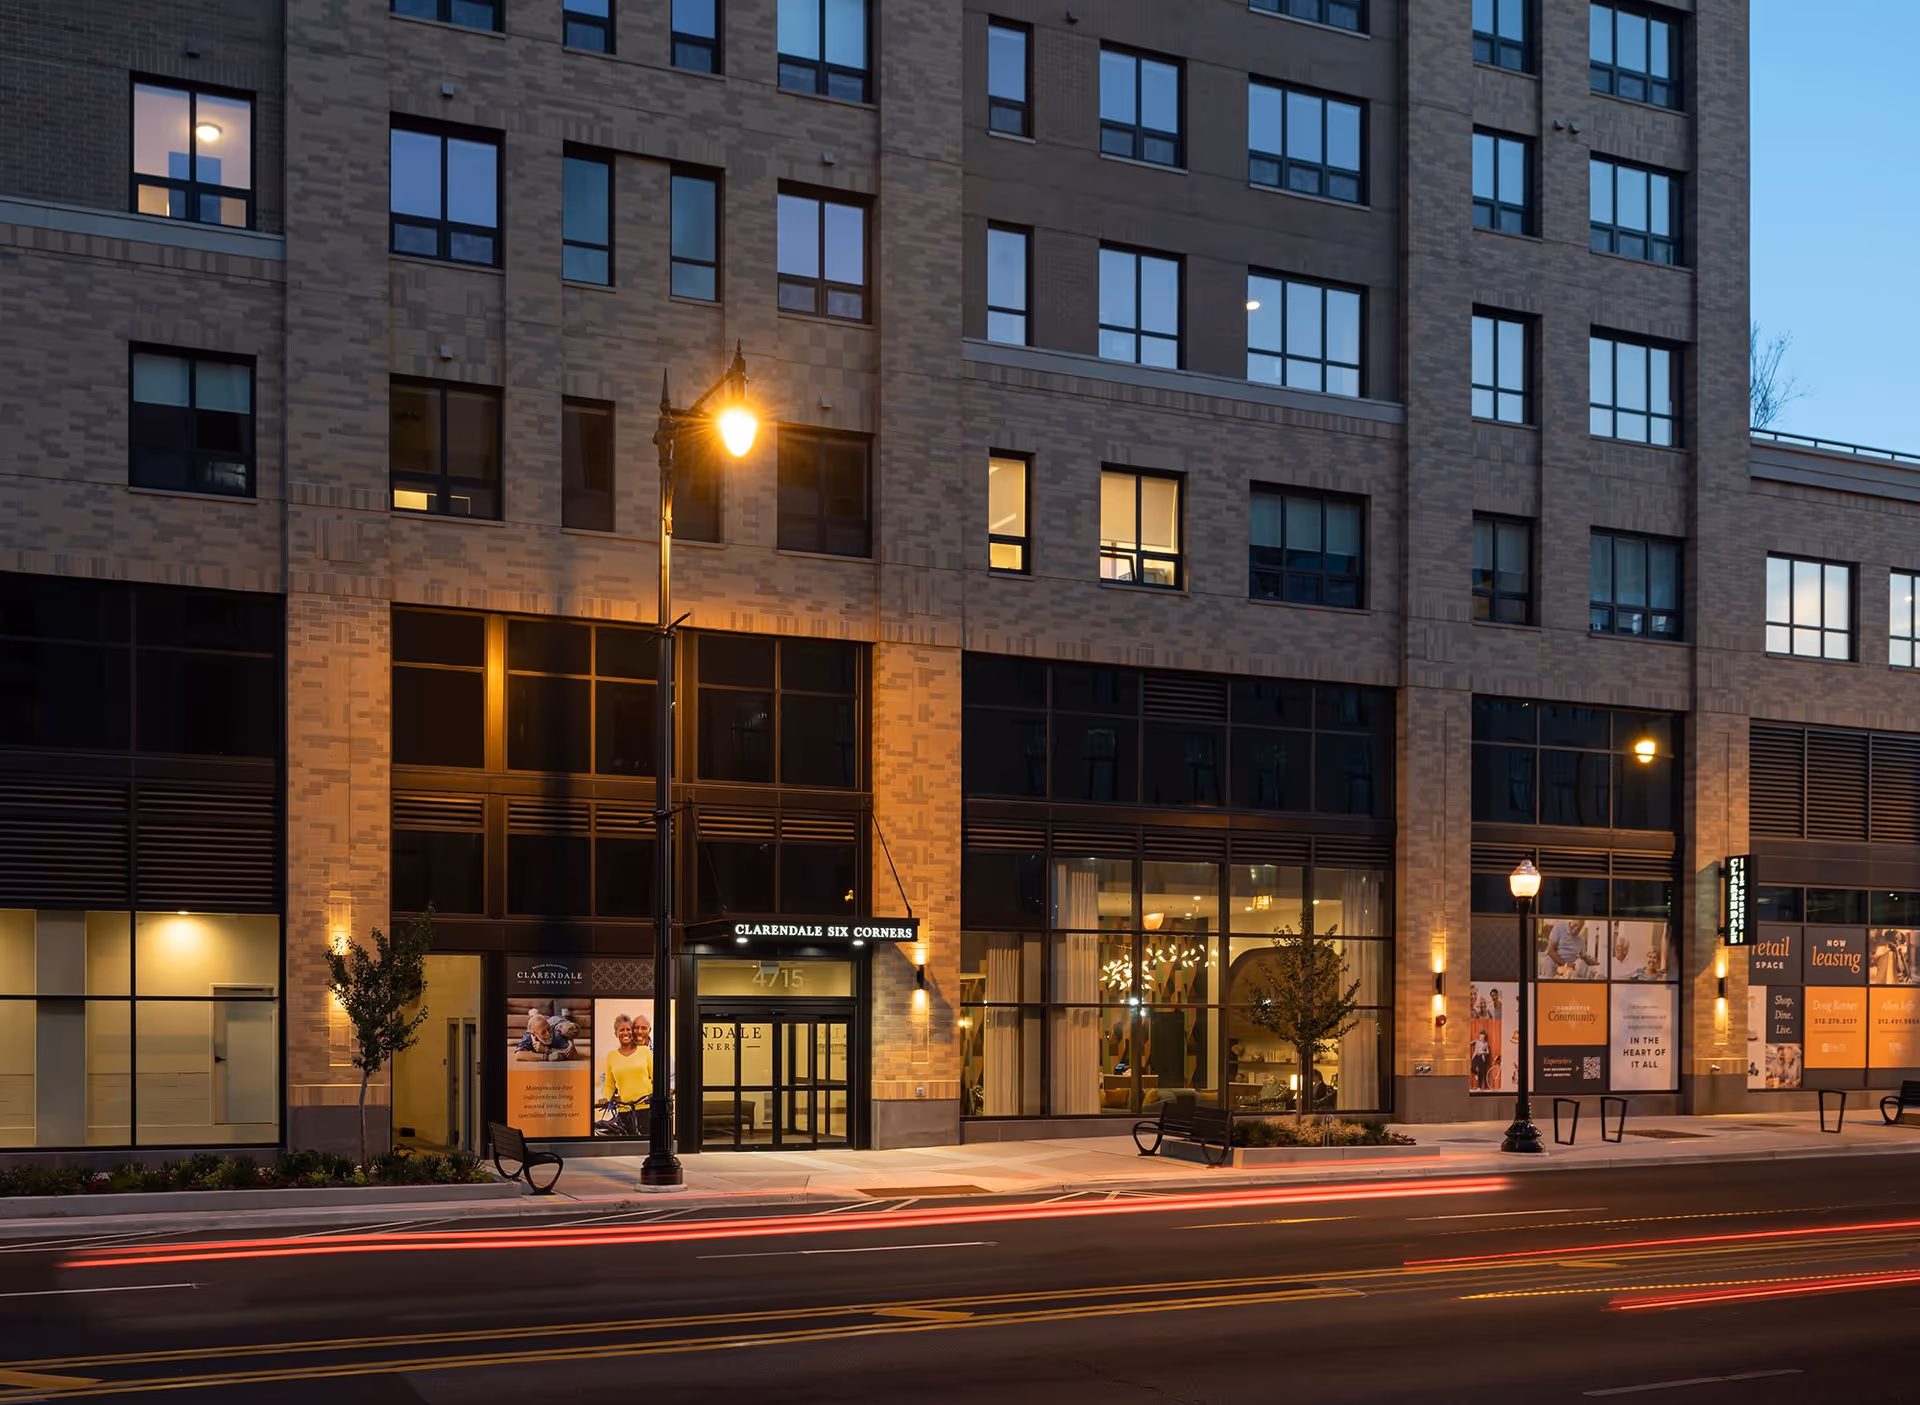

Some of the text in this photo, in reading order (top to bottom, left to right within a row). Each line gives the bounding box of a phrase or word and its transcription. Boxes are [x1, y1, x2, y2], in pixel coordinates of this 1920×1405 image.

[1730, 858, 1739, 944] CLARENDALE
[735, 924, 913, 939] CLARENDALE SIX CORNERS
[1752, 936, 1790, 957] retail
[1755, 961, 1784, 969] SPACE
[1812, 946, 1862, 974] leasing
[516, 971, 583, 980] CLARENDALE
[1774, 995, 1794, 1008] Shop.
[1548, 1010, 1597, 1025] Community
[1774, 1010, 1794, 1020] Dine.
[1775, 1024, 1793, 1034] Live.
[1622, 1048, 1667, 1057] HEART OF
[1631, 1061, 1659, 1069] IT ALL
